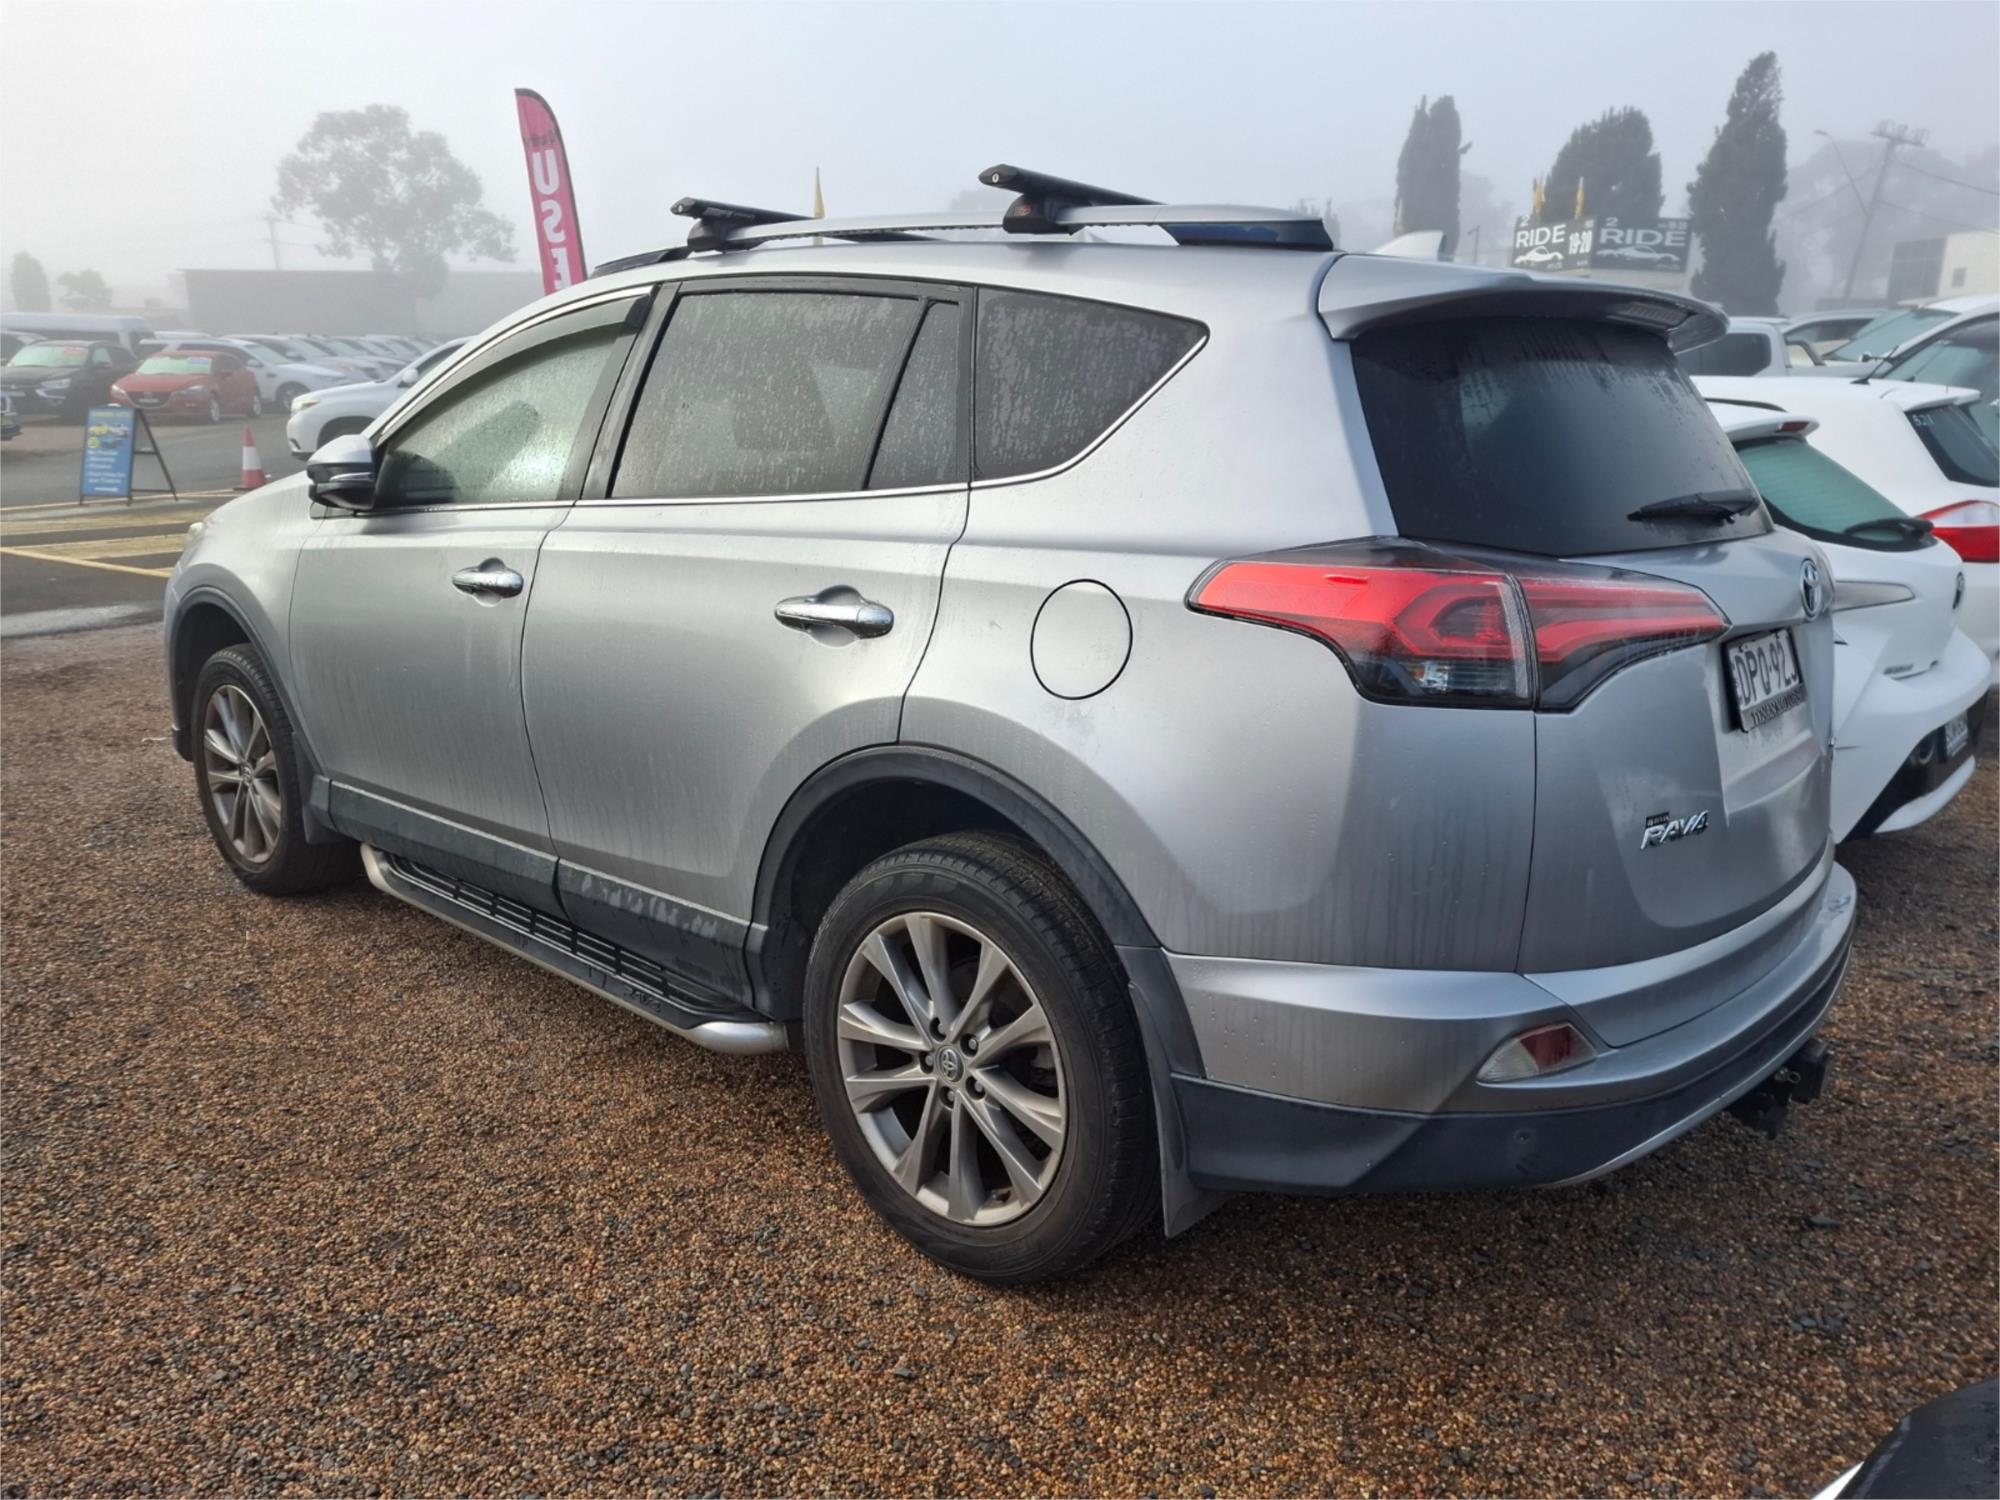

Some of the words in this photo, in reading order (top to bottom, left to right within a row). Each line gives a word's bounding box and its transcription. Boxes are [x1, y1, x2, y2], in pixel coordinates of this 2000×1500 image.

[1515, 224, 1567, 249] RIDE
[1599, 228, 1687, 247] RIDE
[1640, 810, 1709, 850] RAV4
